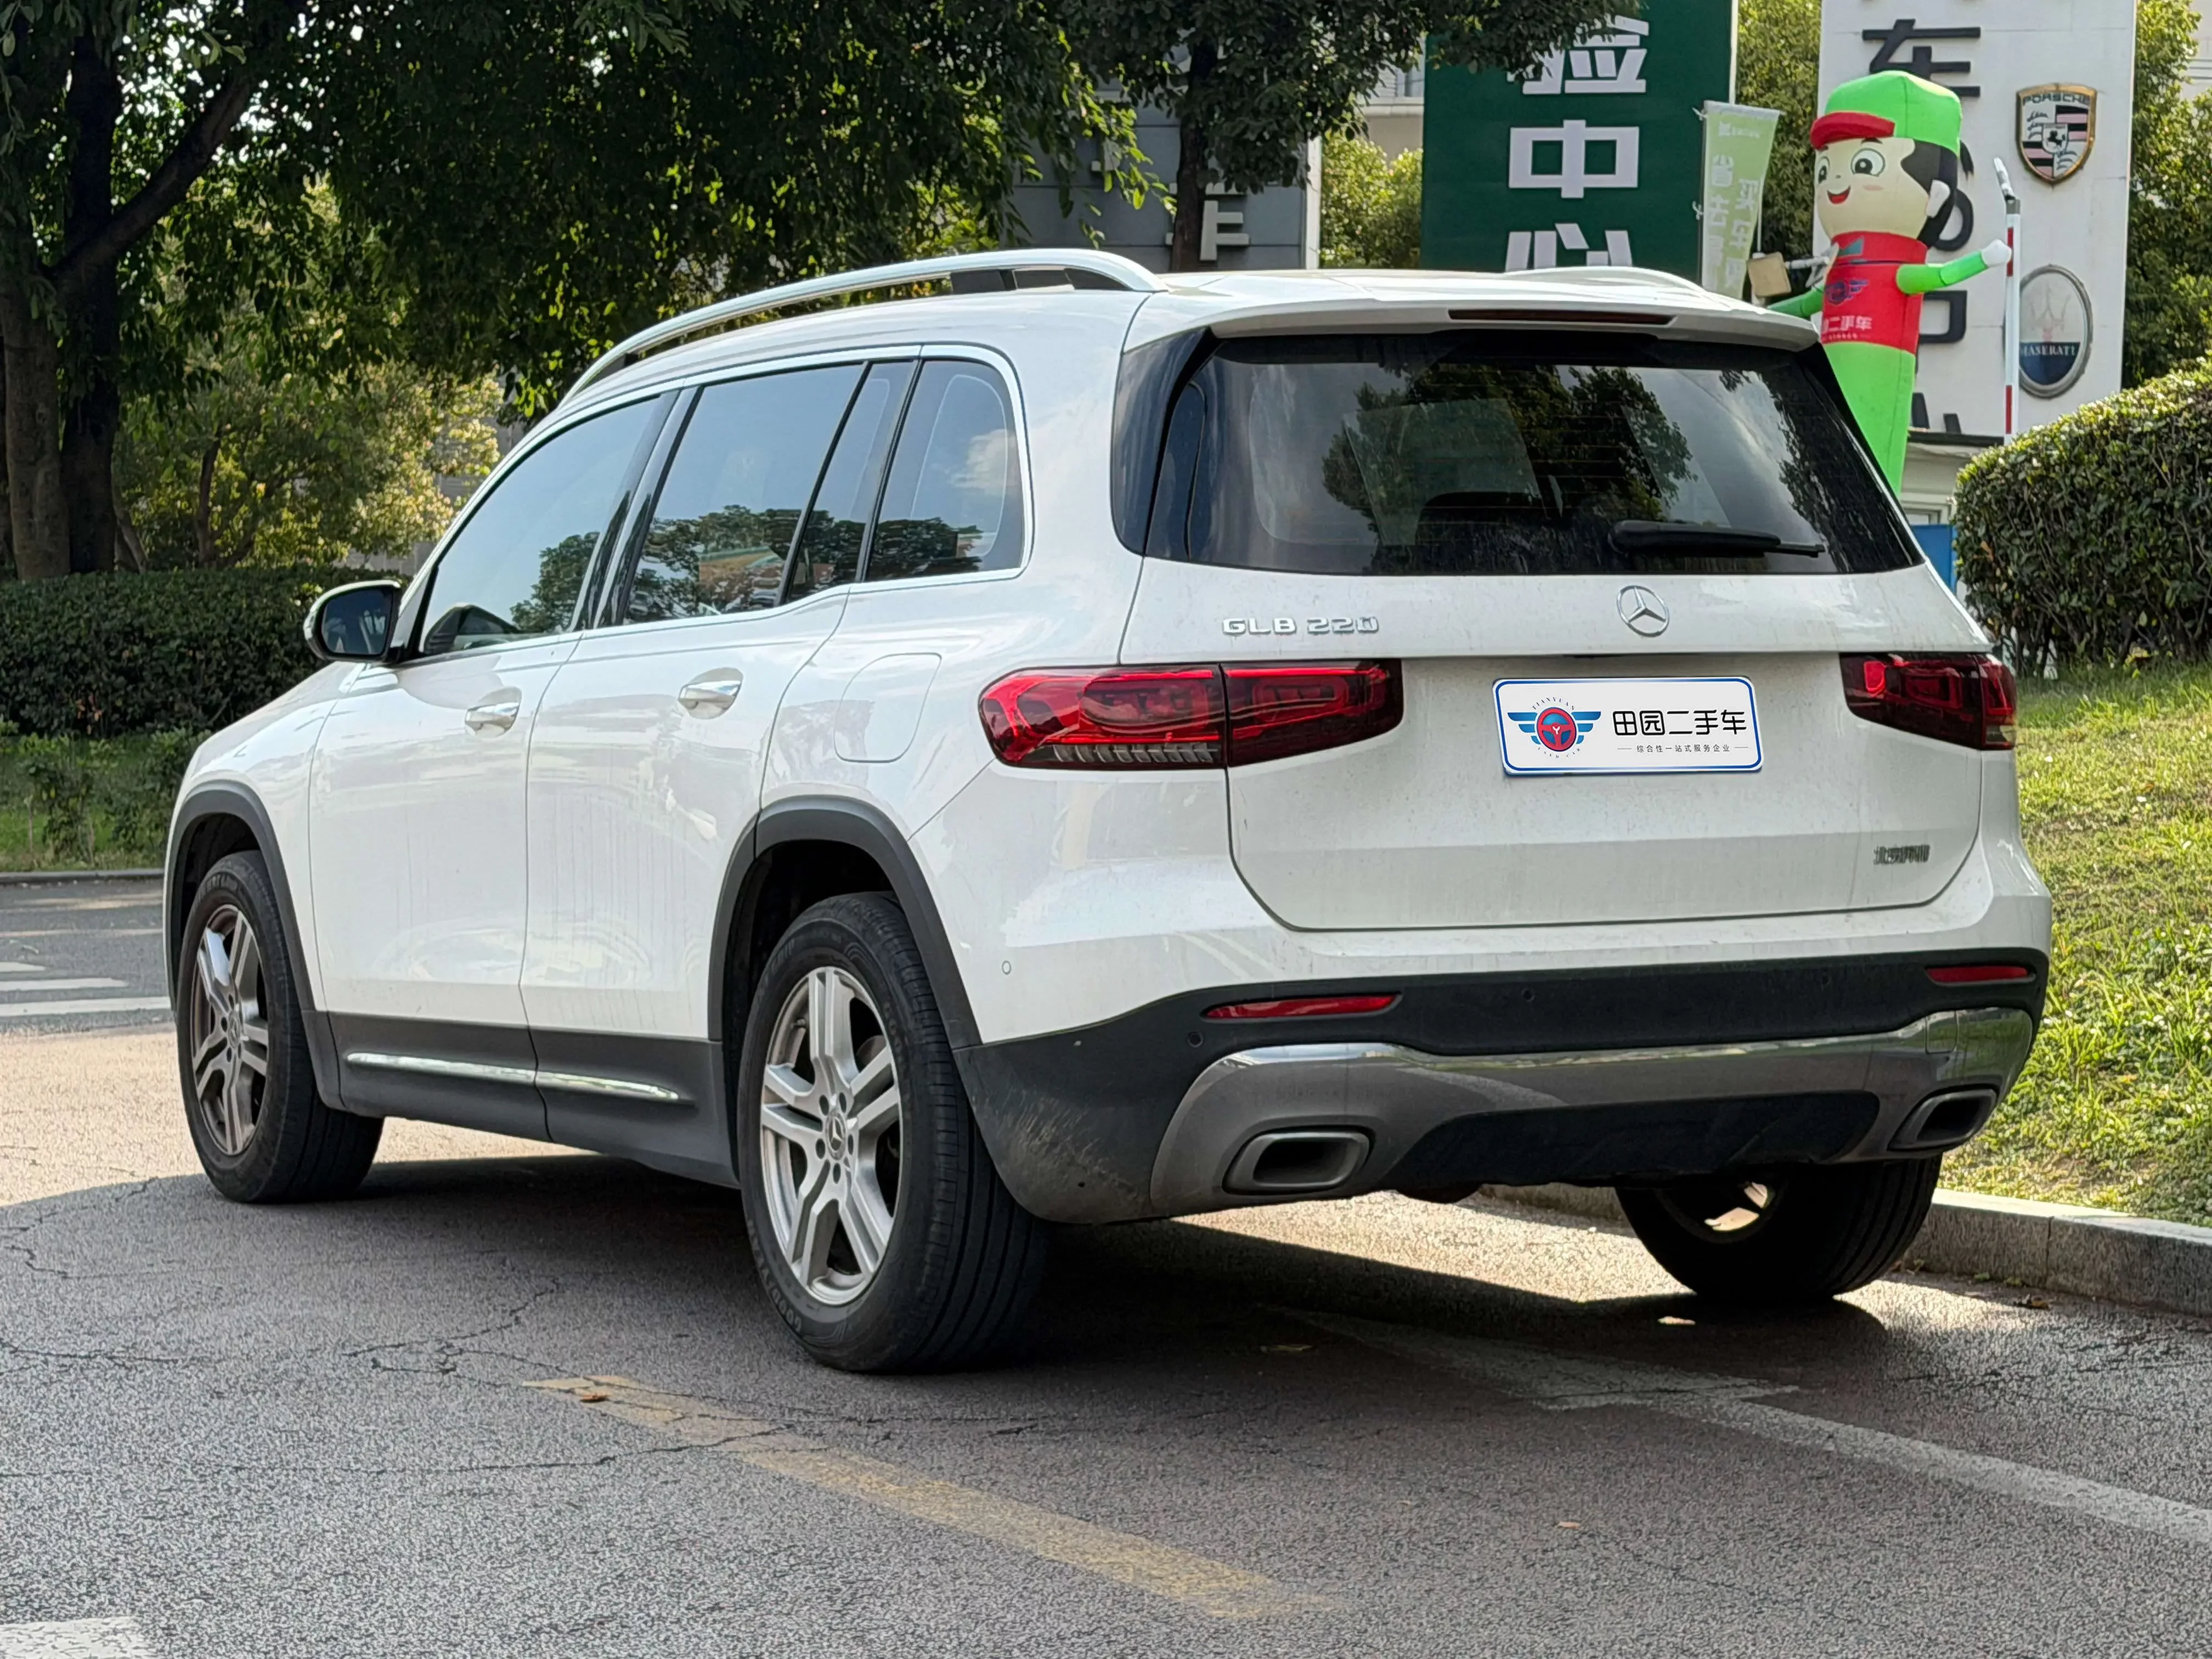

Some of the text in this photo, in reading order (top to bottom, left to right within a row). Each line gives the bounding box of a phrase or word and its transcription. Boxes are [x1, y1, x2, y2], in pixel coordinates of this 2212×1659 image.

[2023, 92, 2091, 106] PORSCHE
[1222, 616, 1380, 635] GLB 220
[1612, 709, 1747, 736] 田园二手车
[1637, 744, 1730, 753] 综合性一站式服务企业
